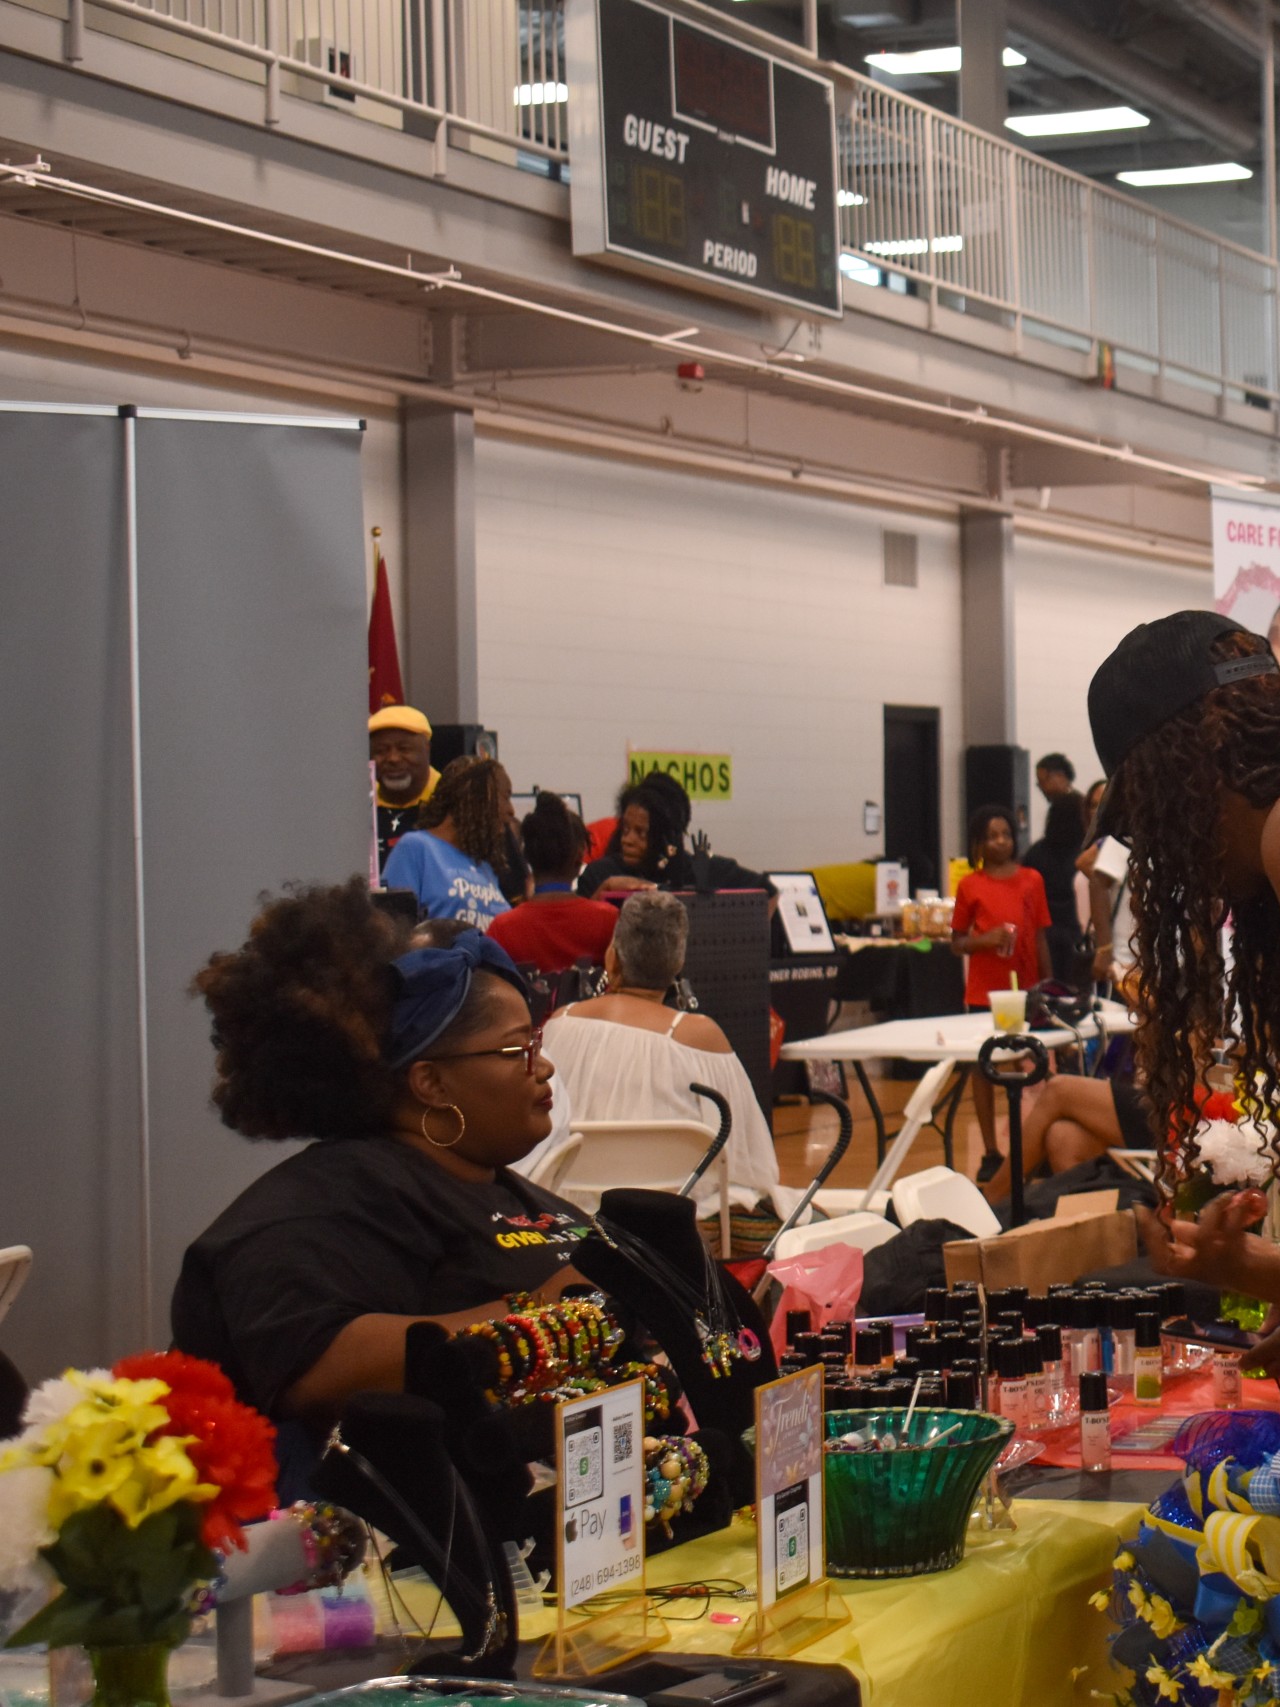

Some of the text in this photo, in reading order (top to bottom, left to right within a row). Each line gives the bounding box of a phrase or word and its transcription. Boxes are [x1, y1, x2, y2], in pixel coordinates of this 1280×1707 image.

[623, 113, 690, 164] GUEST
[765, 165, 817, 211] HOME
[703, 239, 758, 278] PERIOD
[1226, 520, 1264, 547] CARE
[581, 1508, 607, 1540] Pay
[570, 1553, 641, 1598] (248) 694-1398
